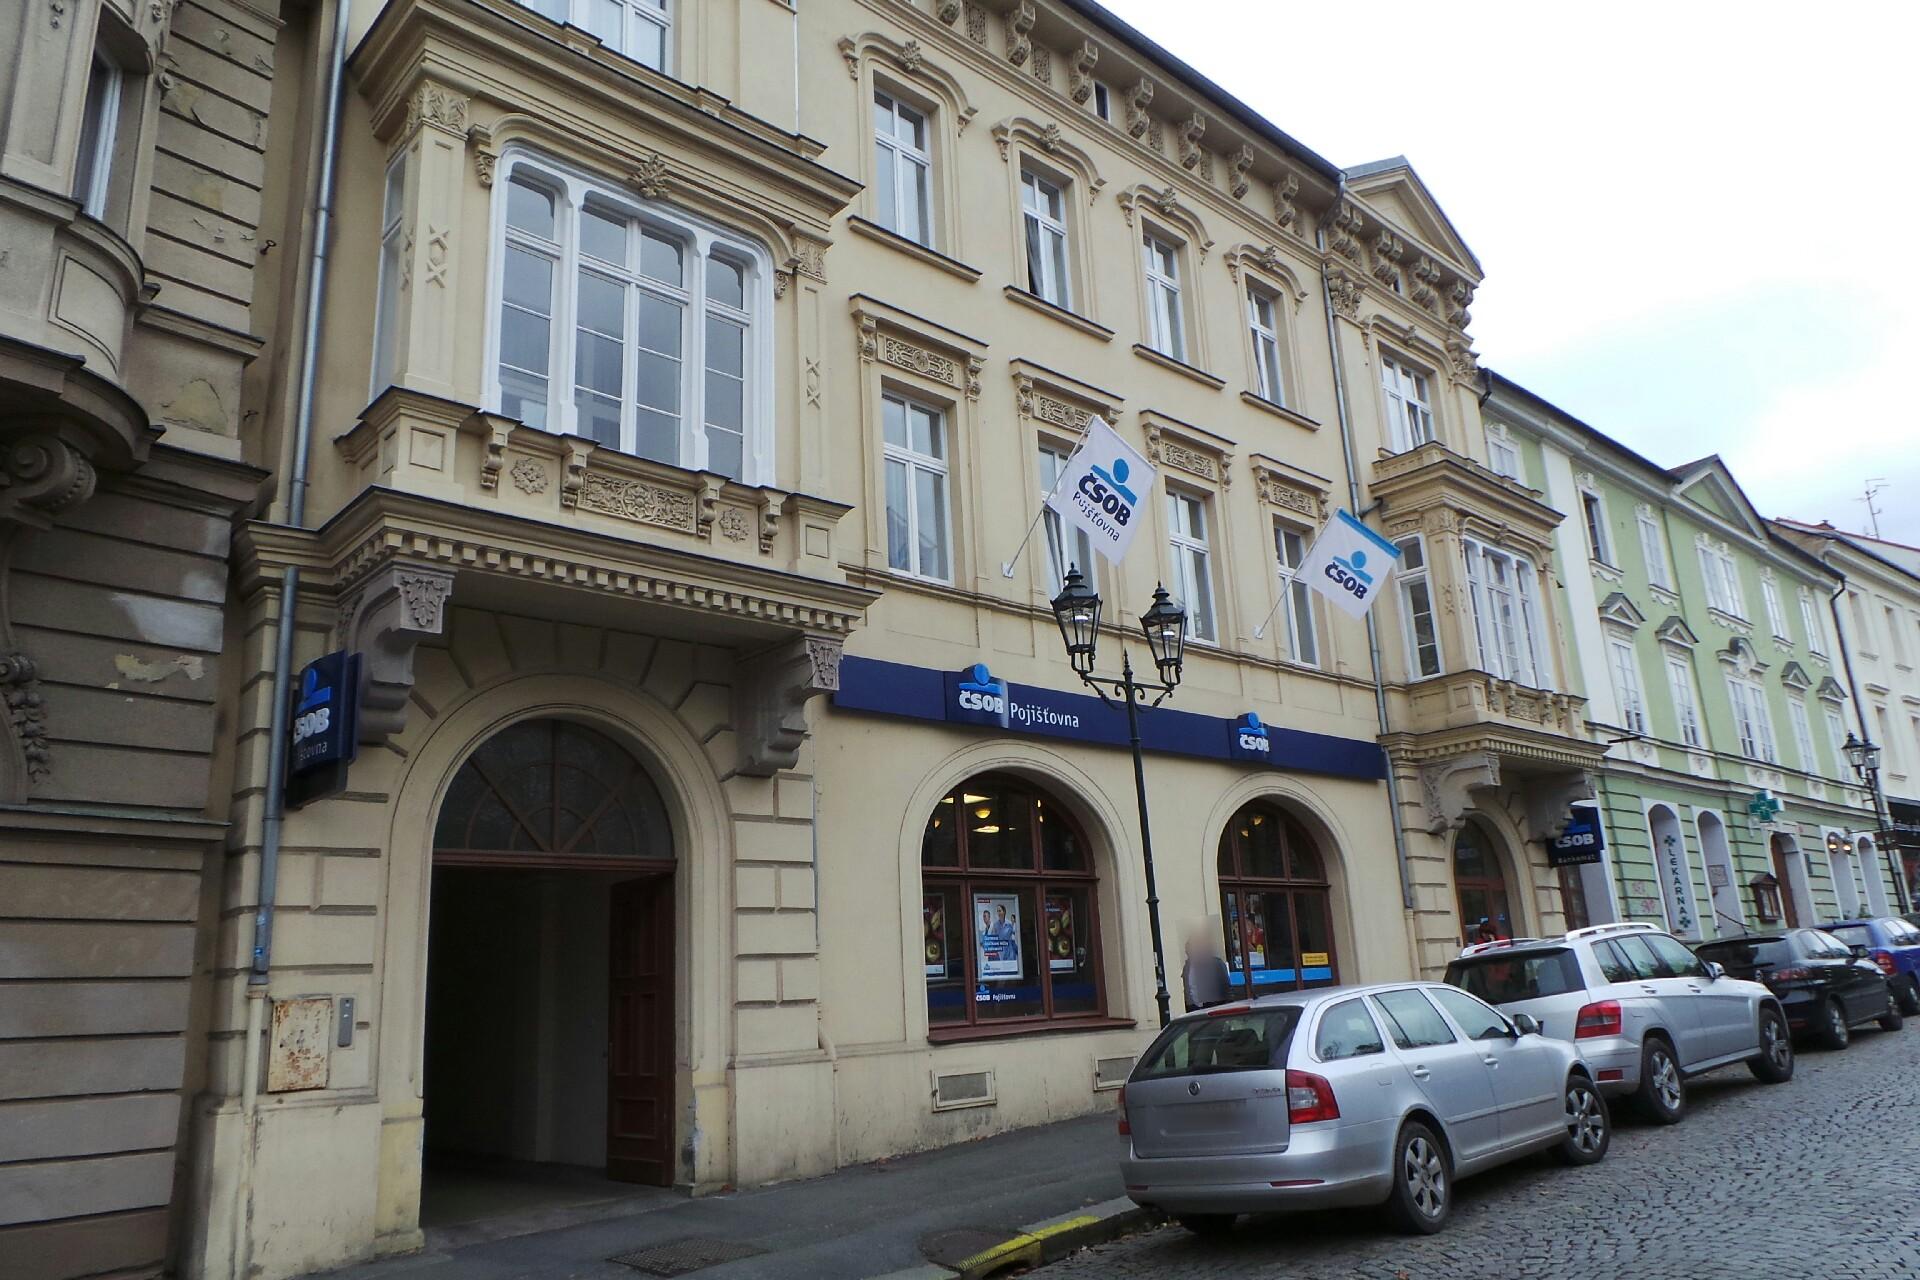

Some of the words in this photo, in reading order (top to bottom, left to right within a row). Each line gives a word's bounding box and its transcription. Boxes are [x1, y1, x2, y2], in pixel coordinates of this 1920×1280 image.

[1078, 472, 1131, 527] ČSOB
[1324, 561, 1368, 600] ČSOB
[958, 690, 1004, 714] ČSOB
[1009, 702, 1080, 728] Pojišťovna
[1239, 734, 1270, 752] ČSOB
